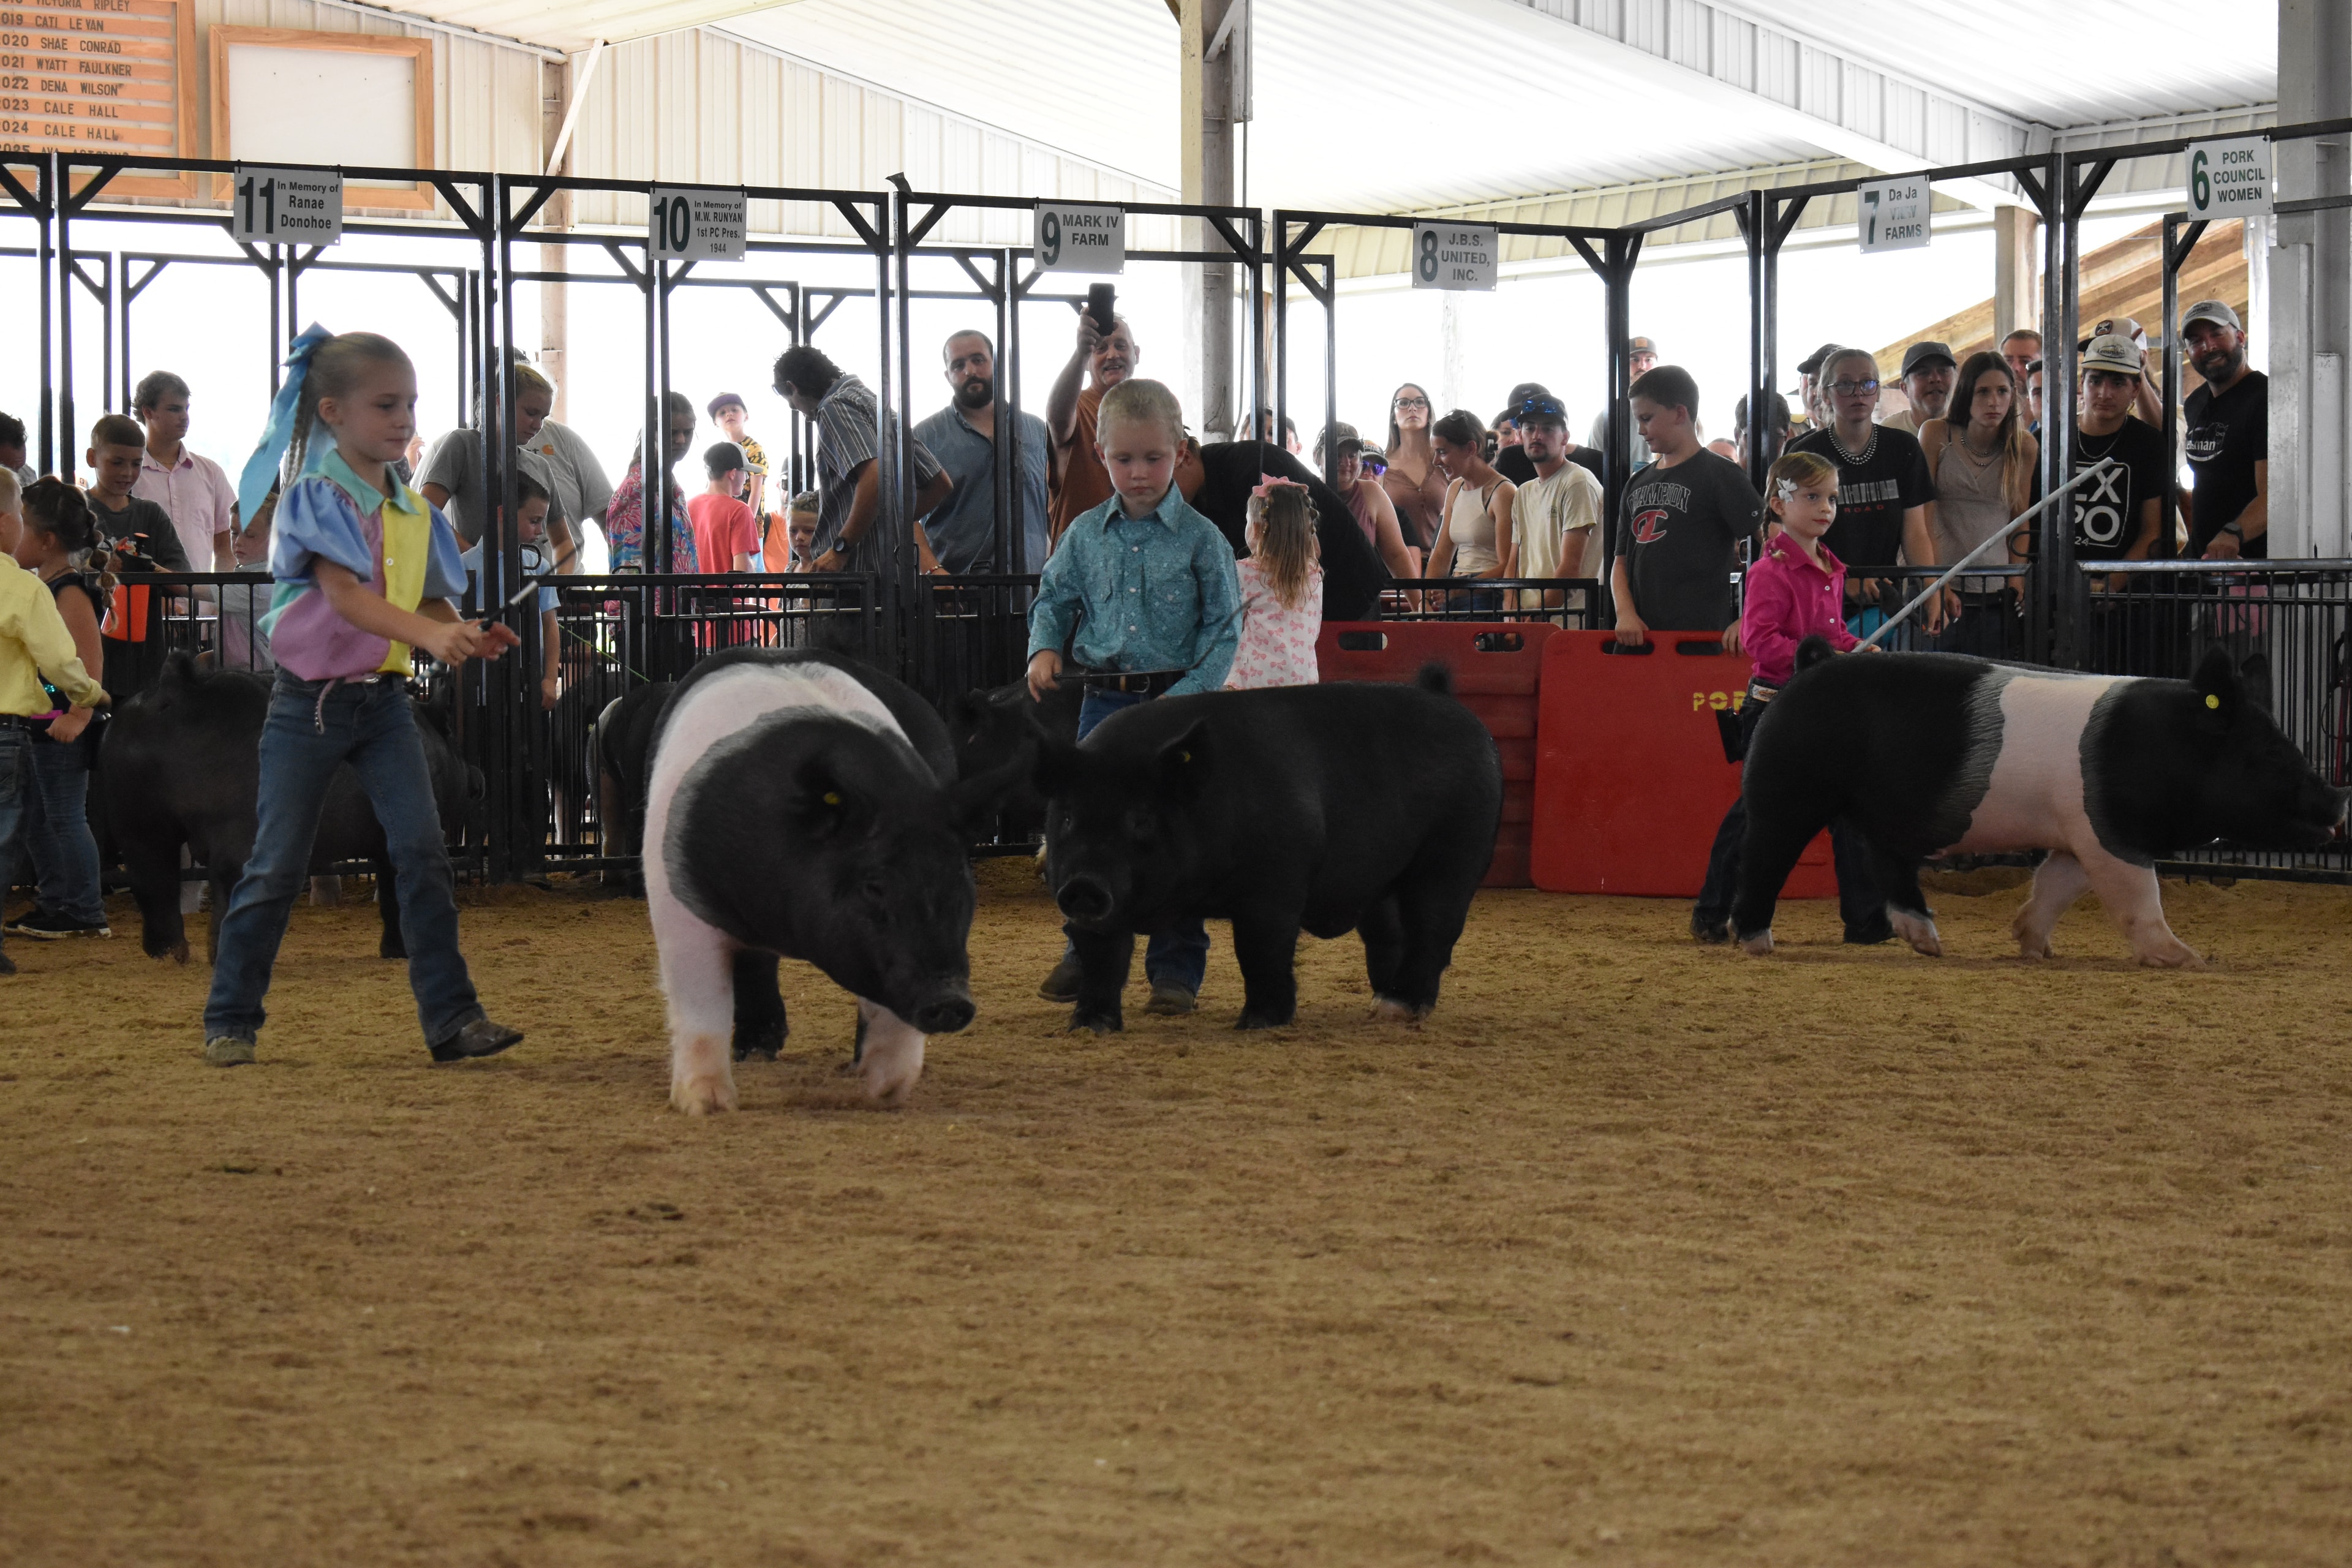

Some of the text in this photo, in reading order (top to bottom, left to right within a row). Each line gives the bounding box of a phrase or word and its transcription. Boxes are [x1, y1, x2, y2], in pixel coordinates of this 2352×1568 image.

[94, 0, 130, 12] RIPLEY
[35, 15, 58, 28] CATI
[0, 34, 121, 54] 020 SHAE CONRAD
[1, 55, 132, 77] 021 WYATT FAULKNER
[0, 76, 118, 96] 022 DENA WILSON
[0, 98, 119, 118] 023 CALE HALL
[0, 120, 119, 141] 024 CALE HALL
[2222, 149, 2255, 165] PORK
[2192, 149, 2211, 211] 6
[2214, 168, 2266, 184] COUNCIL
[277, 181, 339, 194] In Memory of
[1889, 186, 1918, 201] Da Ja
[2218, 187, 2263, 203] WOMEN
[238, 176, 274, 234] 11
[289, 195, 325, 209] Ranae
[703, 201, 732, 211] Memory
[281, 214, 332, 229] Donohoe
[654, 196, 690, 252] 10
[695, 211, 742, 223] M.W. RUNYAN
[1063, 214, 1119, 228] MARK IV
[1864, 190, 1880, 244] 7
[697, 227, 740, 238] 1st PC Pres.
[1041, 211, 1061, 266] 9
[1072, 233, 1109, 246] FARM
[1449, 233, 1483, 247] J.B.S.
[1885, 224, 1922, 240] FARMS
[710, 243, 726, 253] 1944
[1420, 230, 1438, 282] 8
[1441, 250, 1490, 267] UNITED,
[1452, 268, 1478, 281] INC.
[1627, 482, 1691, 519] CHAMPION
